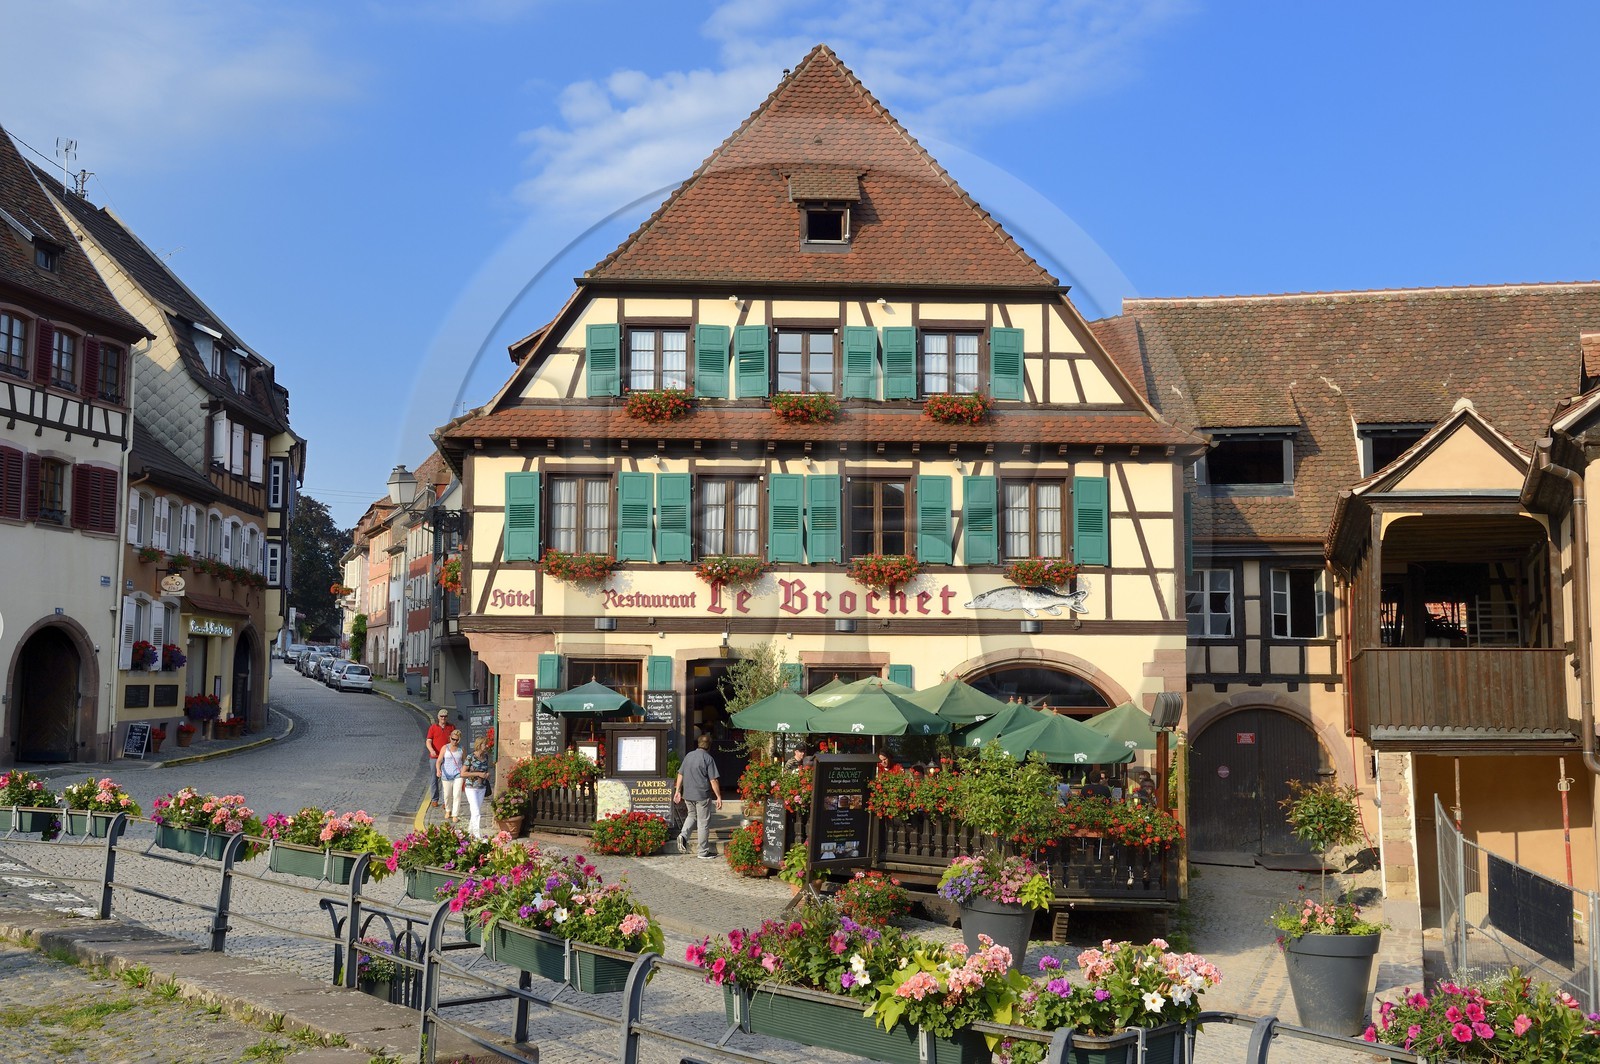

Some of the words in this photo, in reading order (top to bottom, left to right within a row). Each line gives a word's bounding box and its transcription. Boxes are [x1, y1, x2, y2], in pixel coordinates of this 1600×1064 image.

[490, 588, 536, 609] Hôtel
[602, 588, 697, 609] Restaurant
[707, 578, 753, 614] Le
[778, 578, 957, 615] Brochet
[828, 771, 836, 779] LE
[836, 770, 862, 779] BROCHET
[631, 787, 672, 795] FLAMBÉES
